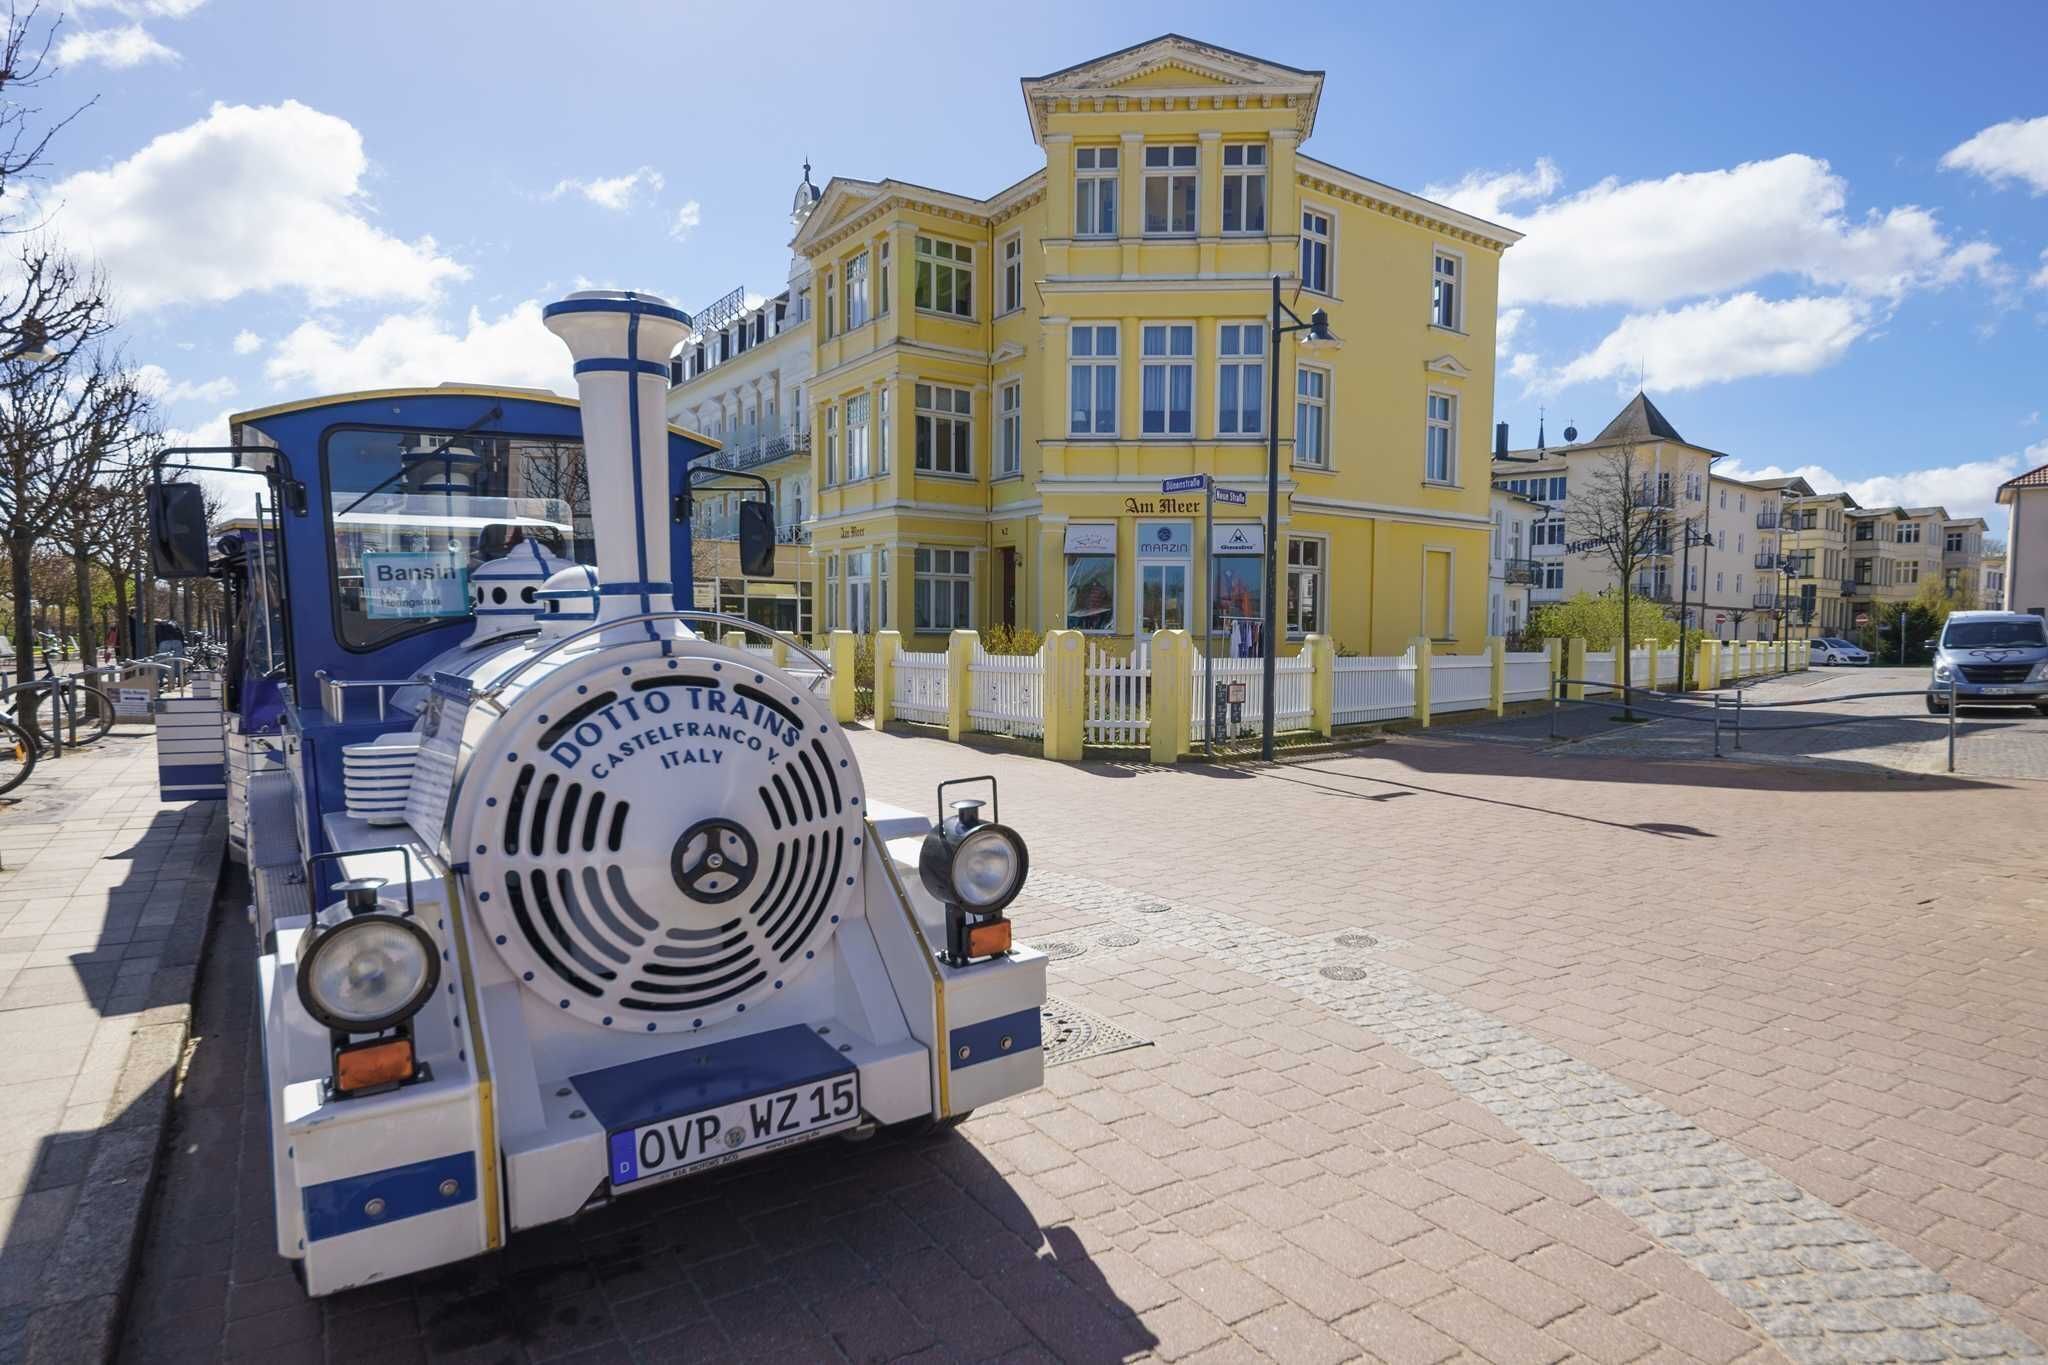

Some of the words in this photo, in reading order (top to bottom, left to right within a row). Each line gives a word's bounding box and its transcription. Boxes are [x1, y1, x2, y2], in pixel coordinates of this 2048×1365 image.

[1124, 497, 1154, 514] Am
[1159, 498, 1201, 514] Meer
[377, 563, 457, 581] Bansin
[550, 690, 670, 769] DOTTO
[685, 687, 800, 748] TRAINS
[591, 721, 762, 779] CASTELFRANCO
[660, 747, 723, 769] ITALY
[639, 1114, 721, 1170] OVP
[750, 1092, 801, 1139] WZ
[810, 1078, 854, 1124] 15
